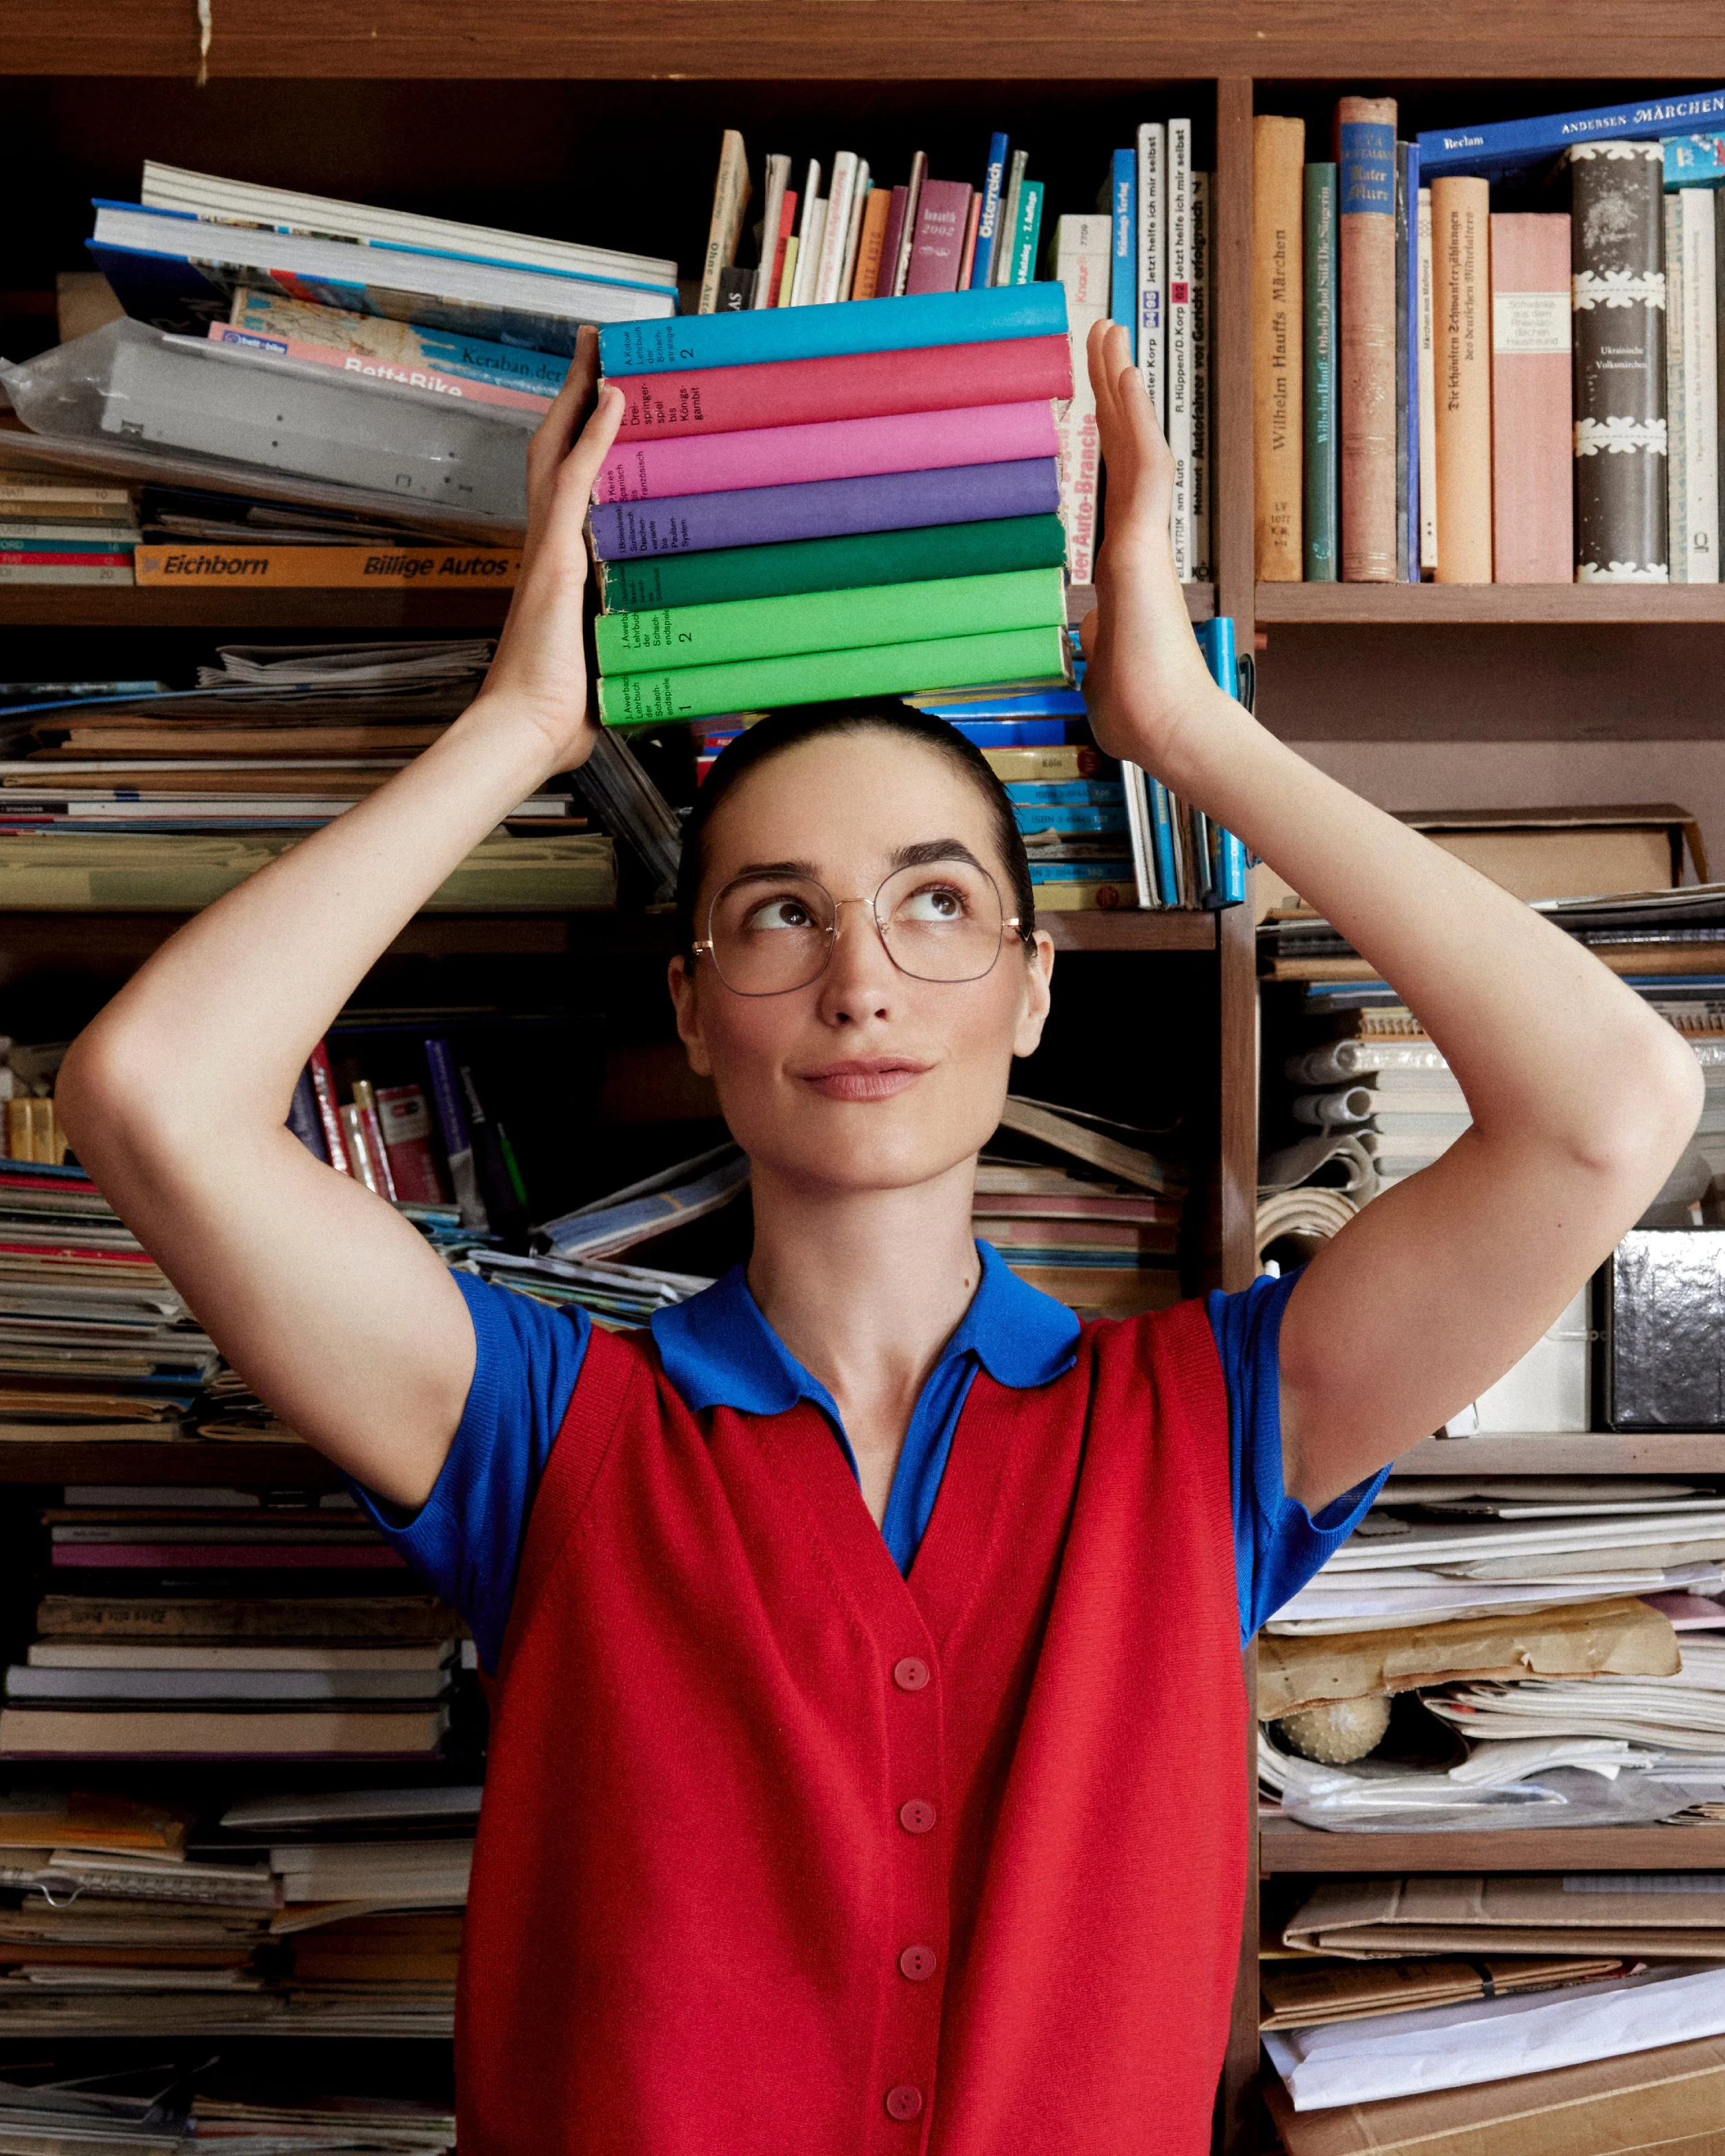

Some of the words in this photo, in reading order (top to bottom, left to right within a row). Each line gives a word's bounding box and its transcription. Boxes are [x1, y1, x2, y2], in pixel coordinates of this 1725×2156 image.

[1561, 115, 1627, 135] ANDERSEN
[1633, 96, 1725, 124] MÄRCHEN
[1147, 136, 1156, 172] selbst
[1175, 129, 1185, 166] selbst
[1443, 135, 1483, 150] Reclam
[1147, 177, 1156, 197] mir
[1175, 170, 1184, 187] mir
[979, 162, 1003, 238] Österreich
[1147, 201, 1156, 219] ich
[1175, 193, 1184, 212] ich
[1147, 221, 1156, 252] helfe
[1175, 217, 1184, 248] helfe
[1191, 200, 1206, 281] erfolgreich
[706, 243, 719, 275] Ohne
[1147, 253, 1156, 283] Jetzt
[1175, 250, 1184, 280] Jetzt
[1272, 230, 1287, 302] Märchen
[1175, 284, 1185, 301] 62
[1192, 286, 1204, 342] Gericht
[634, 326, 644, 365] Lehrbuch
[654, 330, 664, 363] Schach-
[680, 348, 694, 359] 2
[1147, 339, 1156, 368] Korp
[1272, 311, 1287, 368] Hauffs
[1194, 344, 1204, 370] vor
[535, 363, 563, 382] der
[1317, 360, 1329, 395] Hauff
[630, 402, 640, 426] Drei-
[642, 383, 653, 425] springer-
[654, 401, 665, 424] spiel
[669, 407, 677, 422] bis
[679, 386, 689, 422] Königs-
[691, 387, 703, 421] gambit
[1272, 377, 1287, 451] Wilhelm
[1448, 390, 1461, 411] Die
[1192, 375, 1204, 460] Autofahrer
[1317, 398, 1329, 443] Wilhelm
[616, 464, 629, 502] Spanisch
[1072, 414, 1096, 547] Auto-Branche
[1175, 459, 1184, 488] Auto
[1176, 493, 1184, 511] am
[649, 520, 658, 550] variante
[681, 519, 690, 547] System
[1175, 517, 1184, 578] ELEKTRIK
[164, 554, 269, 575] Eichborn
[364, 555, 433, 577] Billige
[439, 556, 509, 575] Autos
[1072, 550, 1090, 580] der
[621, 612, 629, 642] Awerba
[642, 633, 651, 647] der
[652, 615, 661, 646] Schach-
[662, 608, 672, 646] endspiele
[679, 632, 692, 642] 2
[632, 682, 643, 719] Lehrbuch
[653, 684, 663, 717] Schach-
[662, 677, 673, 716] endspiele
[1042, 758, 1062, 768] Köln
[1032, 815, 1054, 824] ISBN
